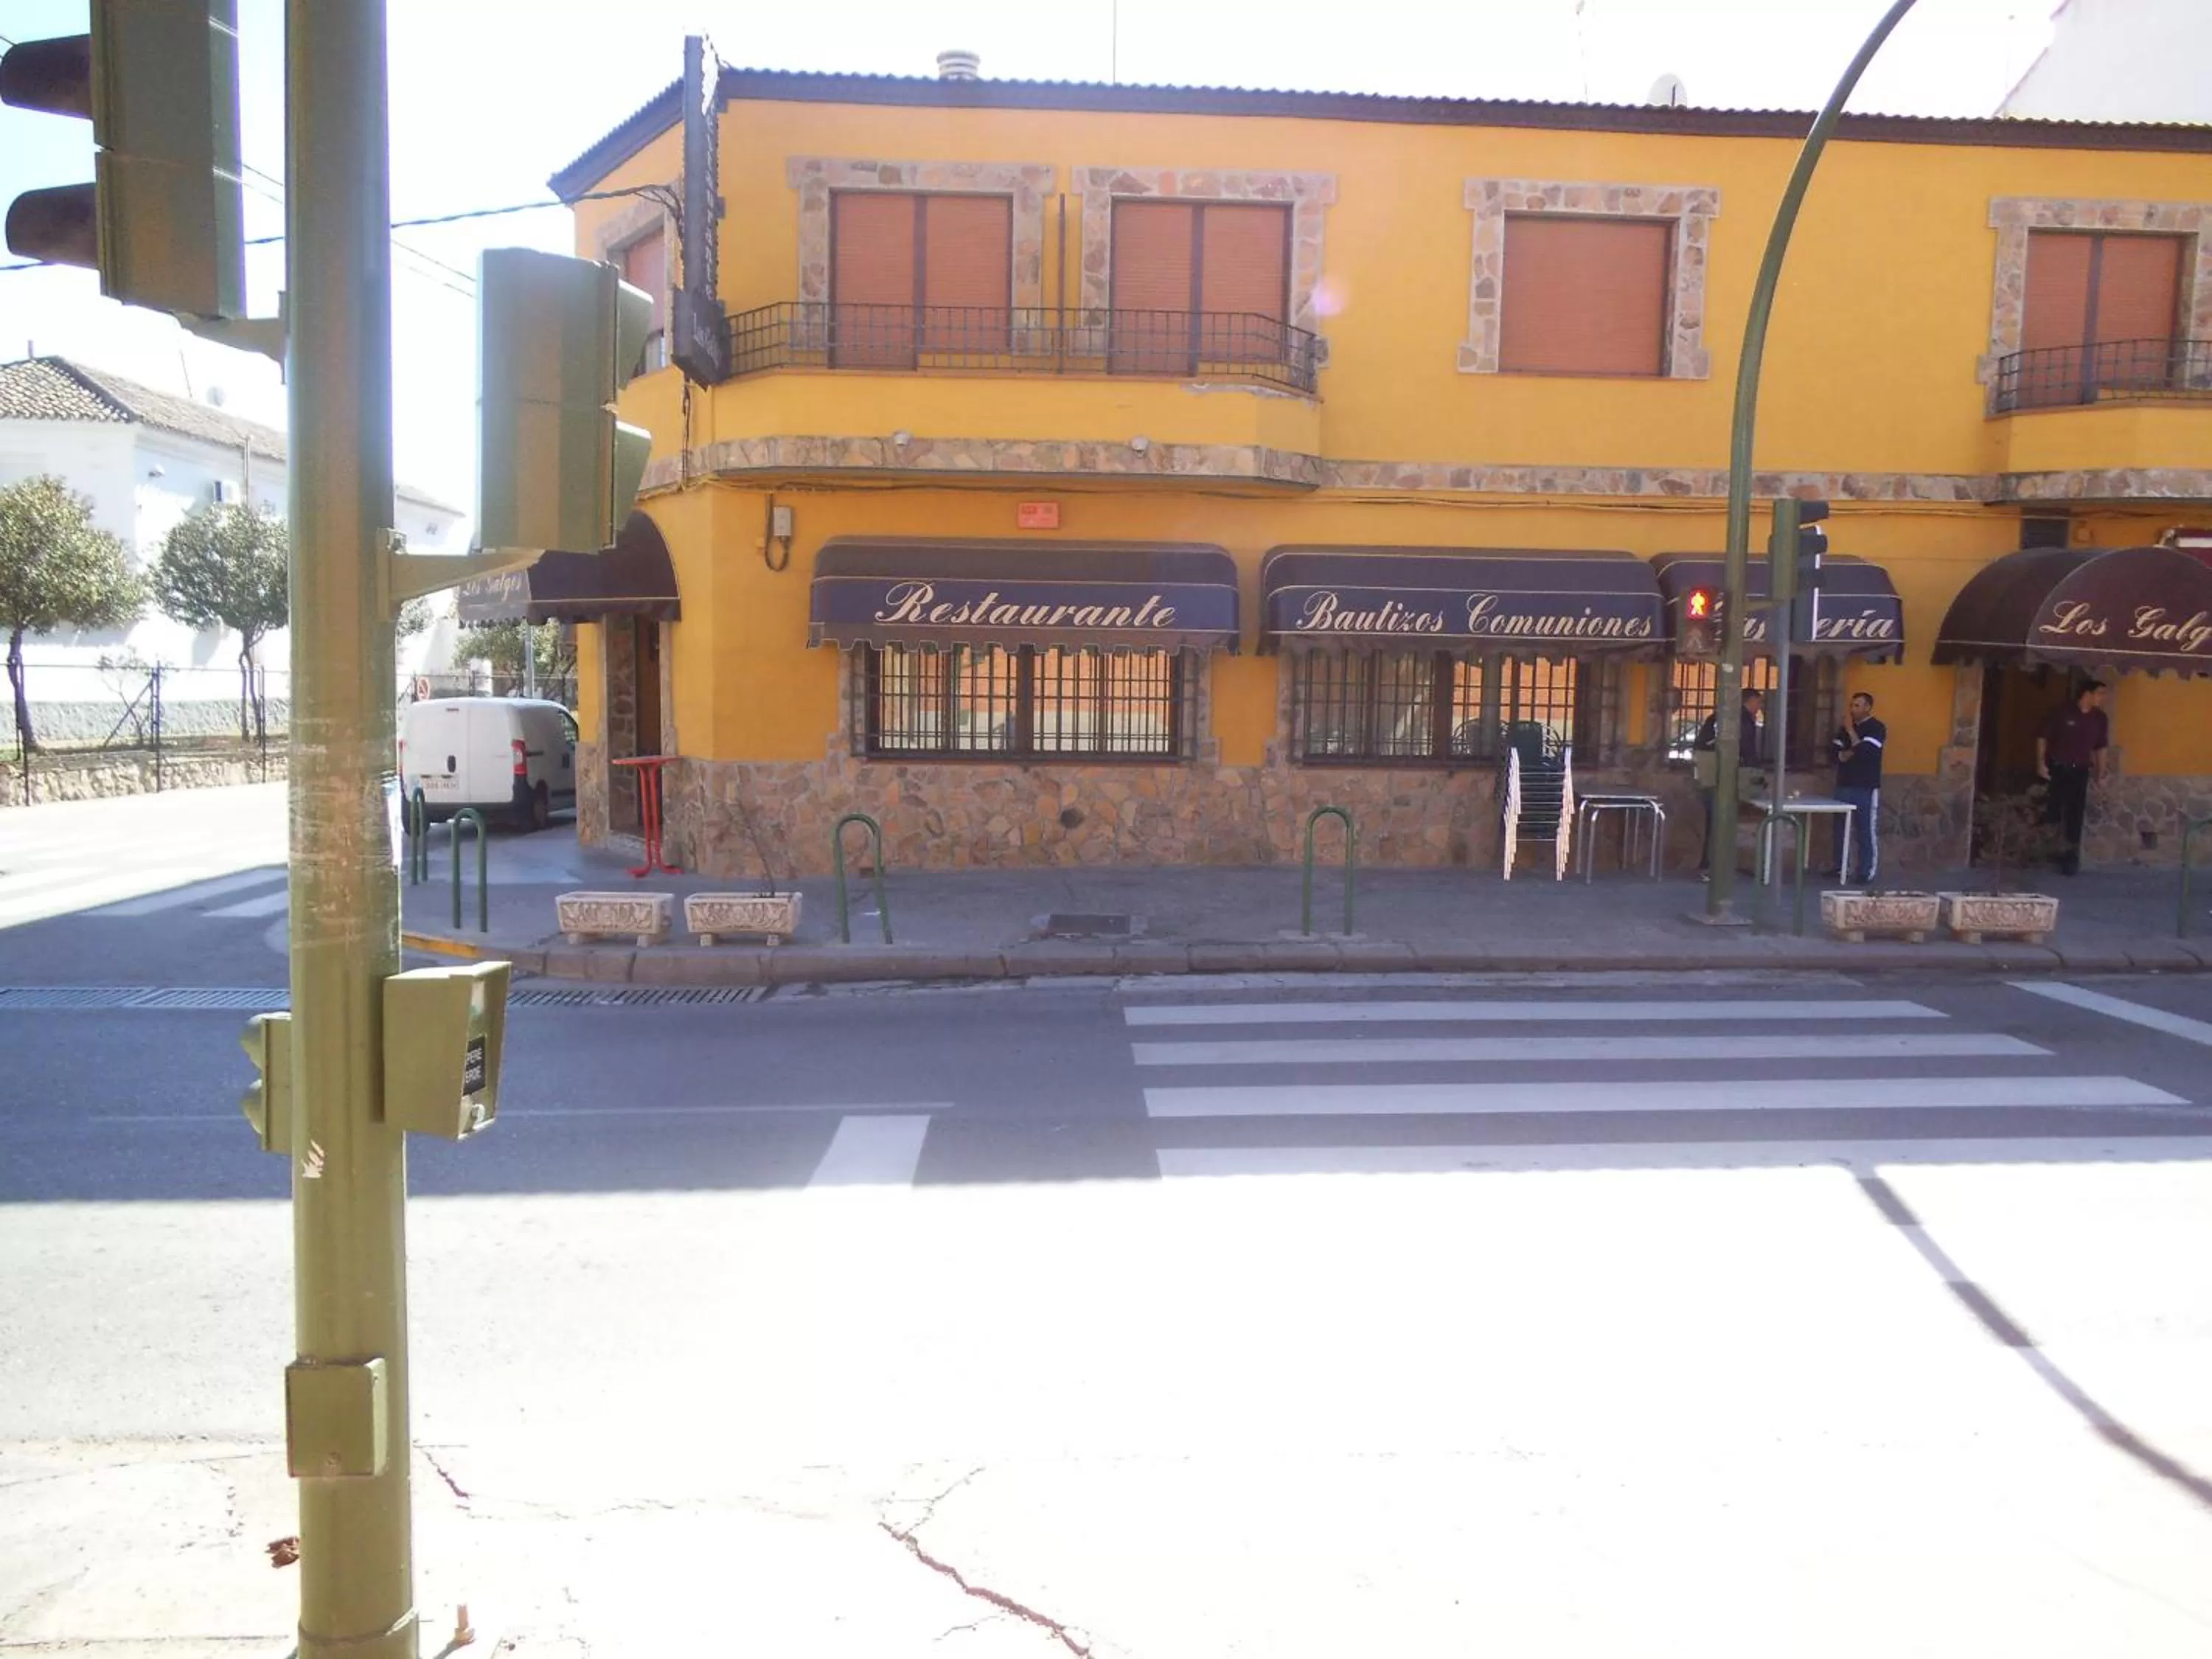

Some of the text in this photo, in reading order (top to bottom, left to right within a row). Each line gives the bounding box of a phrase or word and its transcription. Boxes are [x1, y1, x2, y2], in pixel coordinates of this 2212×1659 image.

[874, 580, 1177, 627] Restaurante
[1295, 590, 1652, 639] Bautizos Comuniones
[2038, 601, 2110, 636] Los
